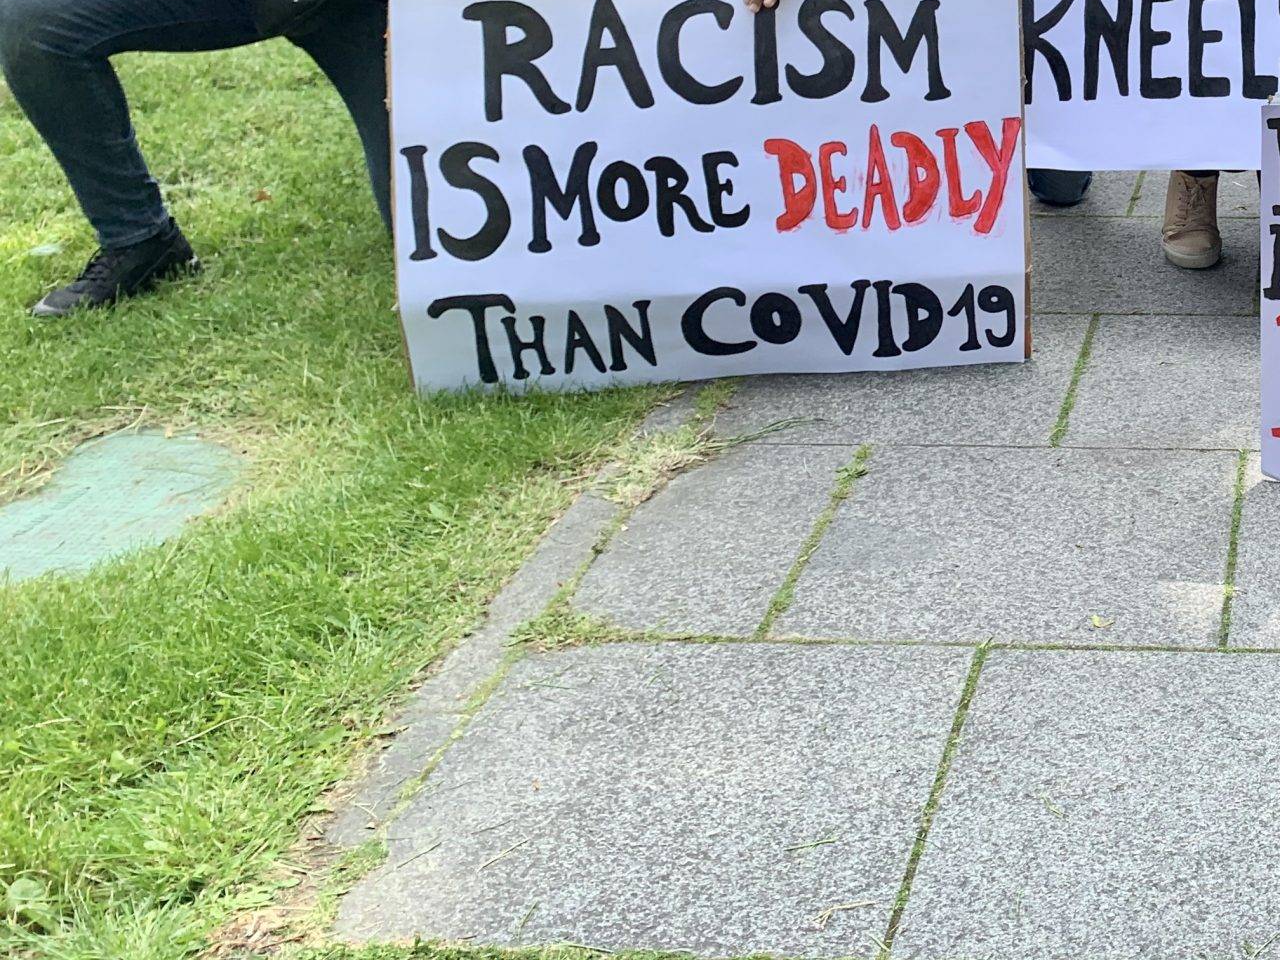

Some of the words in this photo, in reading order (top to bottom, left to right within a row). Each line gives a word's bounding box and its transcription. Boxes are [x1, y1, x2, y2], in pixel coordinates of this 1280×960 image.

[399, 141, 512, 262] IS
[522, 140, 752, 254] MORE
[763, 116, 1022, 235] DEADLY
[427, 292, 659, 384] THAN
